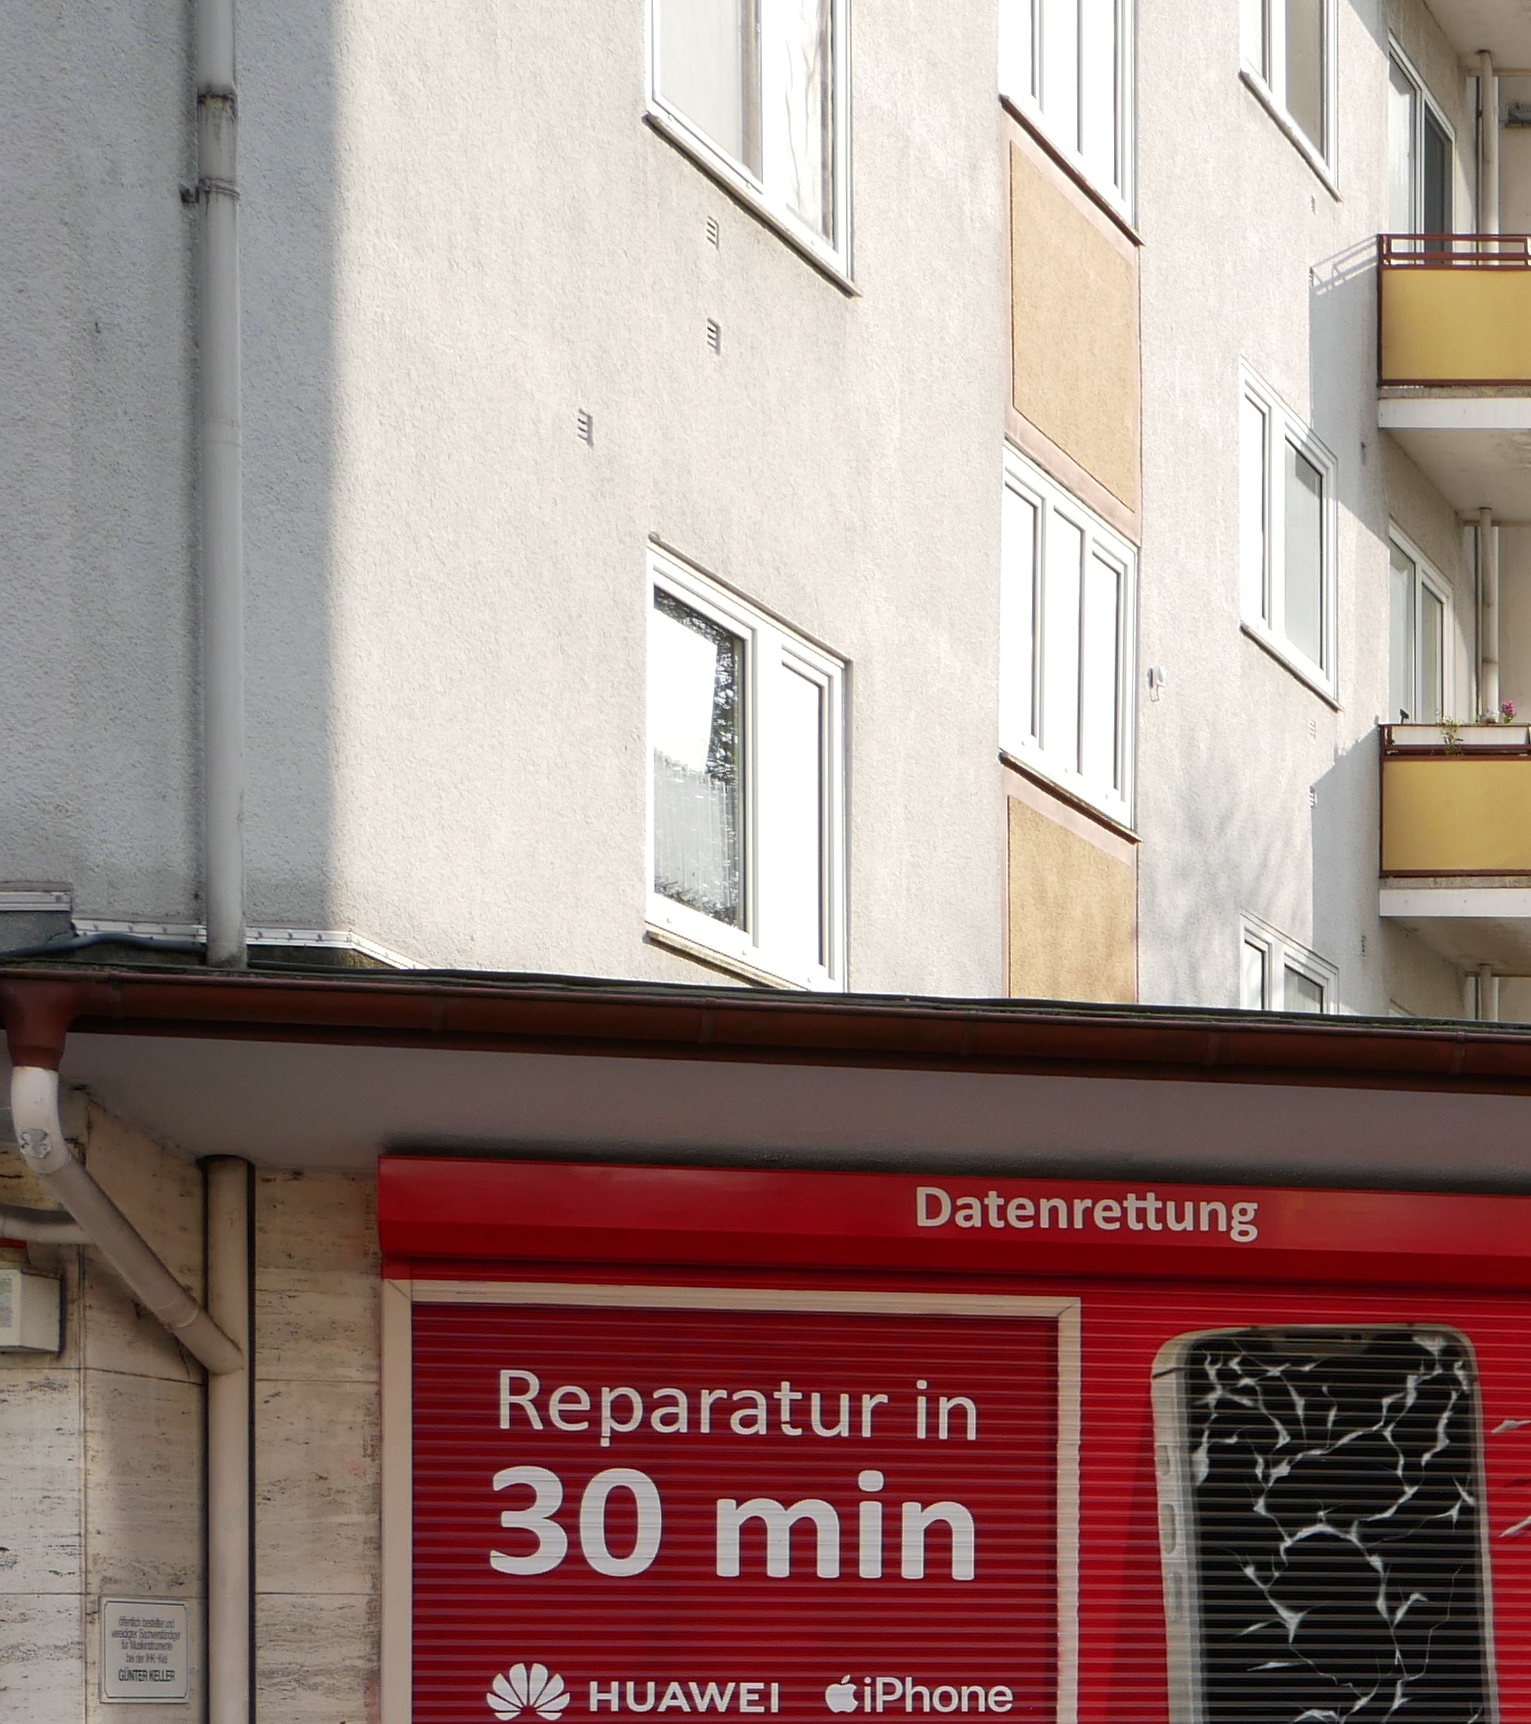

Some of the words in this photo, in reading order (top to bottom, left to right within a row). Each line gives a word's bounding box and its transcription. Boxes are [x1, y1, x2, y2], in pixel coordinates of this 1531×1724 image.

[914, 1186, 1259, 1243] Datenrettung
[498, 1369, 889, 1447] Reparatur
[915, 1380, 978, 1441] in
[489, 1465, 663, 1577] 30
[715, 1470, 976, 1581] min
[118, 1666, 147, 1682] GÜNTER
[148, 1669, 176, 1682] KELLER
[588, 1681, 780, 1713] HUAWEI
[863, 1676, 1014, 1713] iPhone
